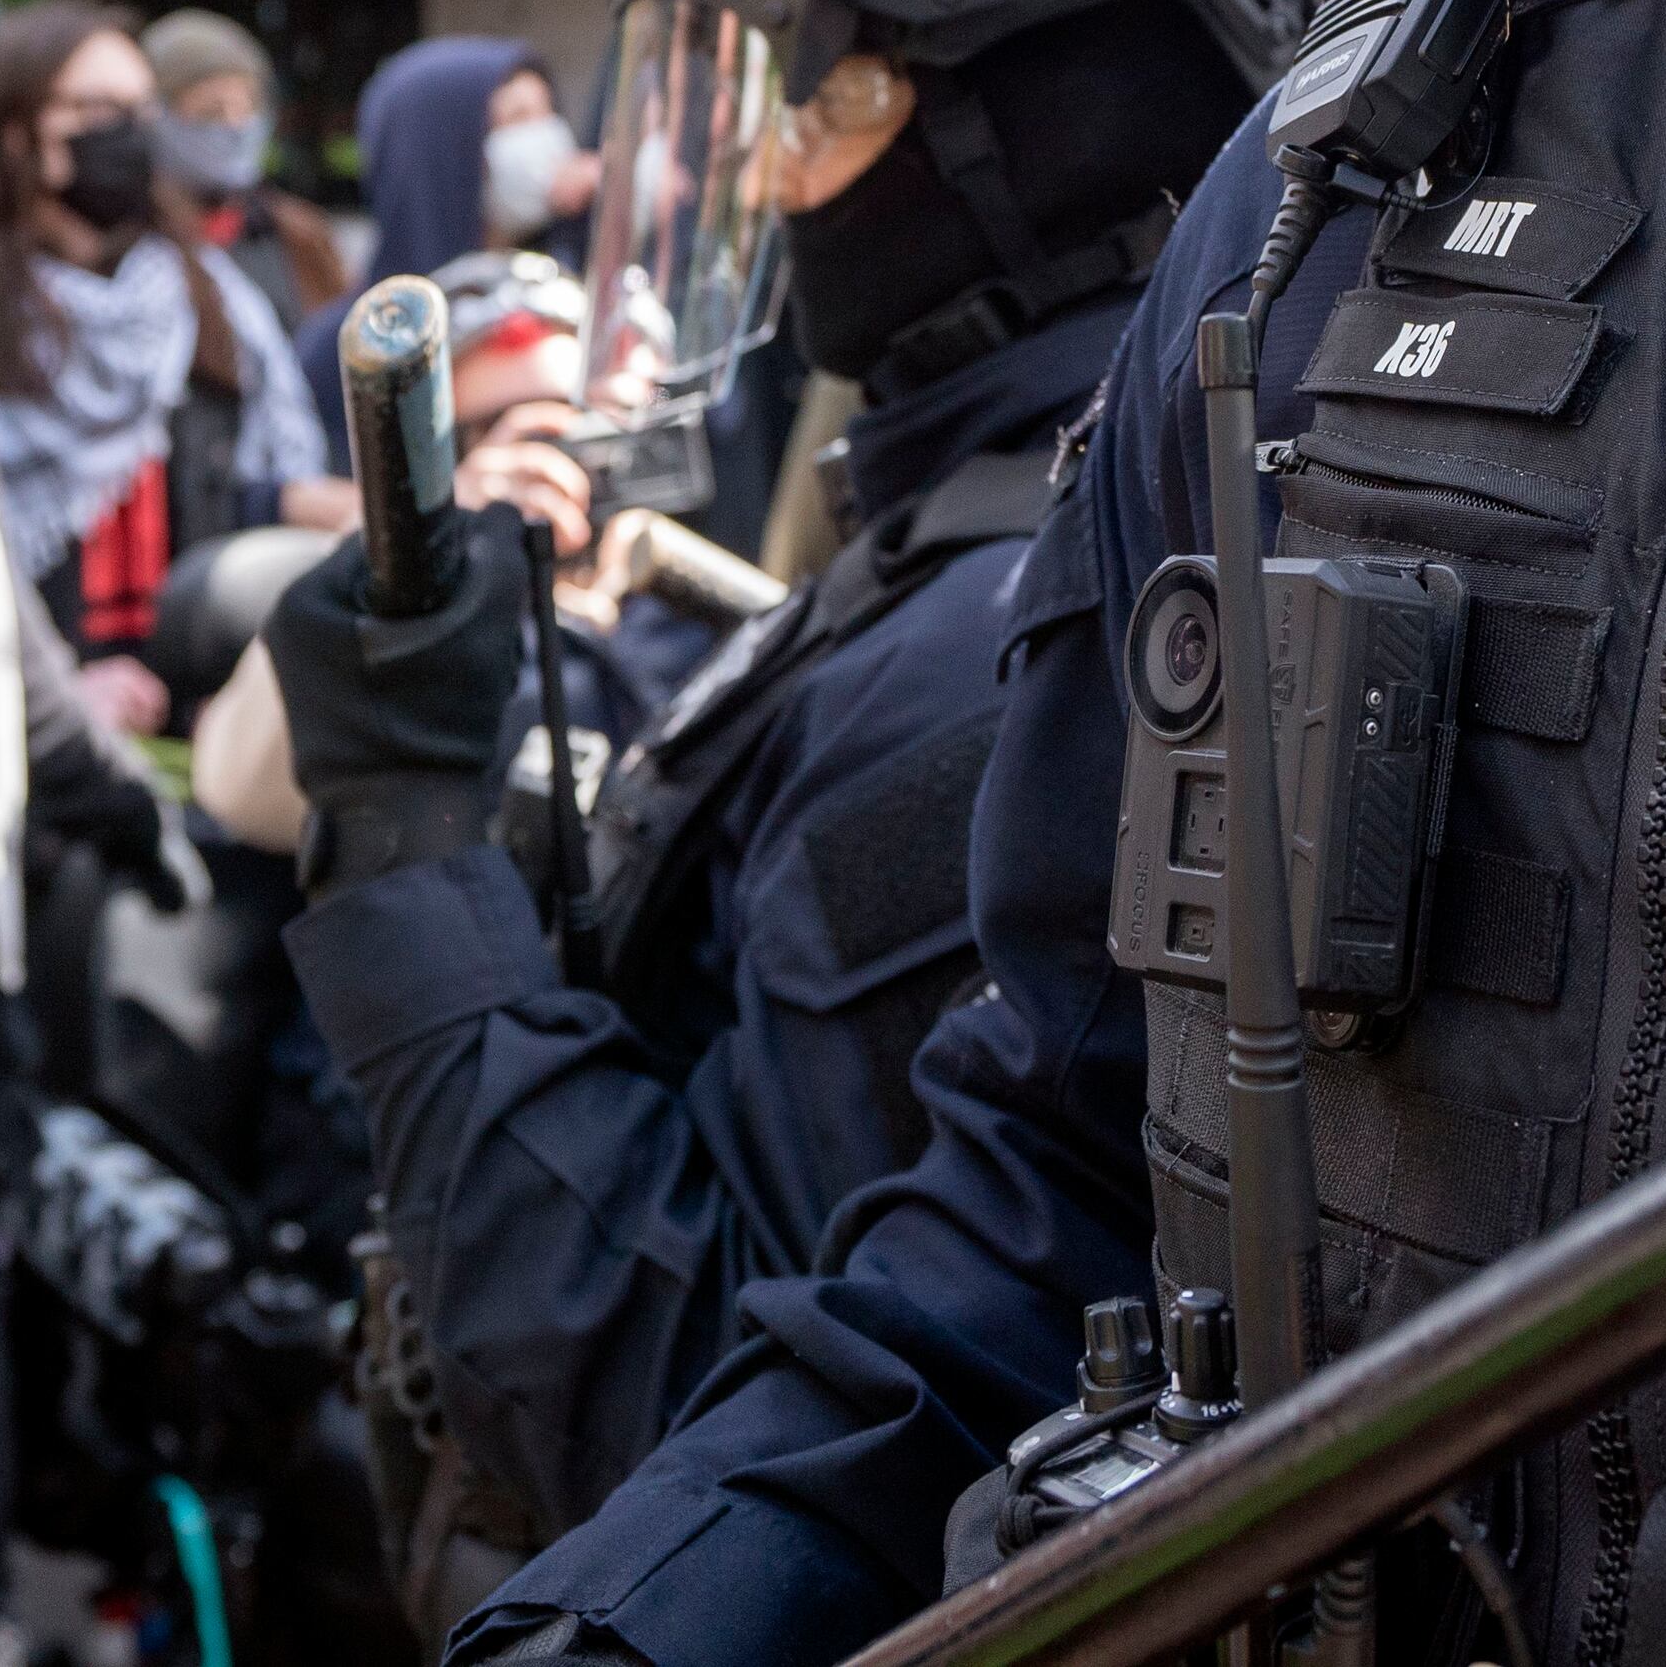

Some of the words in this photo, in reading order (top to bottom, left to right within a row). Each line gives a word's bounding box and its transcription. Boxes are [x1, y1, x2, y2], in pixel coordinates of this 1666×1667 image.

[1443, 199, 1537, 257] MRT
[1373, 320, 1456, 378] X36
[1129, 871, 1148, 953] FOCUS
